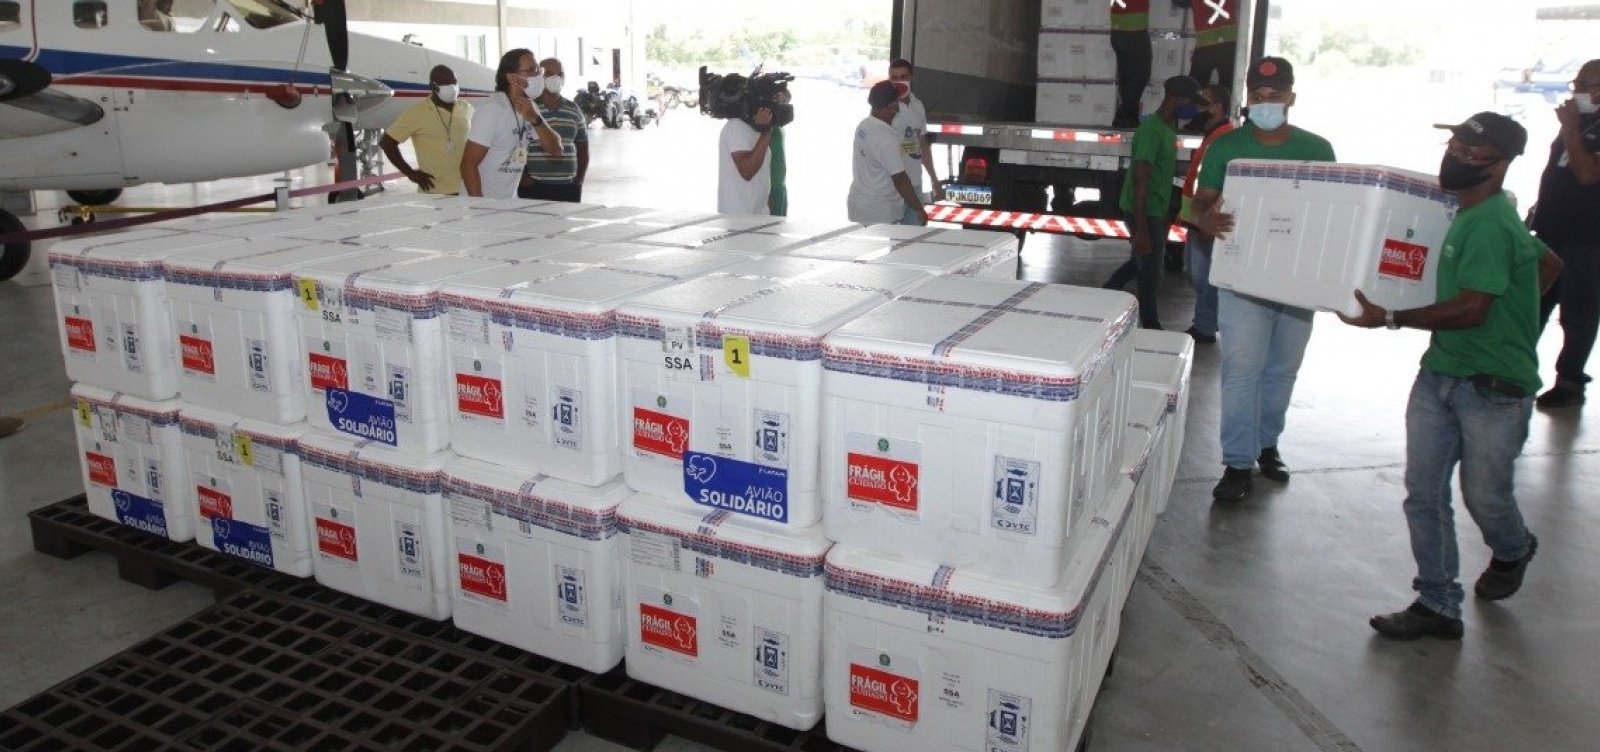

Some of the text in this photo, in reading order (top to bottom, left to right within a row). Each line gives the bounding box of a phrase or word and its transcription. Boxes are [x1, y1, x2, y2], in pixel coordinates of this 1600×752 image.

[305, 288, 312, 300] 1
[322, 310, 342, 324] SSA
[665, 356, 693, 370] SSA
[732, 348, 742, 364] 1
[339, 418, 395, 442] SOLIDÁRIO
[635, 418, 664, 435] FRÁGIL
[217, 450, 235, 464] SSA
[242, 444, 249, 456] 1
[849, 464, 885, 482] FRÁGIL
[848, 477, 887, 490] CUIDADO
[744, 485, 783, 503] AVIÃO
[700, 488, 784, 519] SOLIDÁRIO
[123, 515, 167, 537] SOLIDÁRIO
[224, 543, 271, 566] SOLIDÁRIO
[642, 612, 671, 630] FRÁGIL
[851, 674, 887, 694] FRÁGIL
